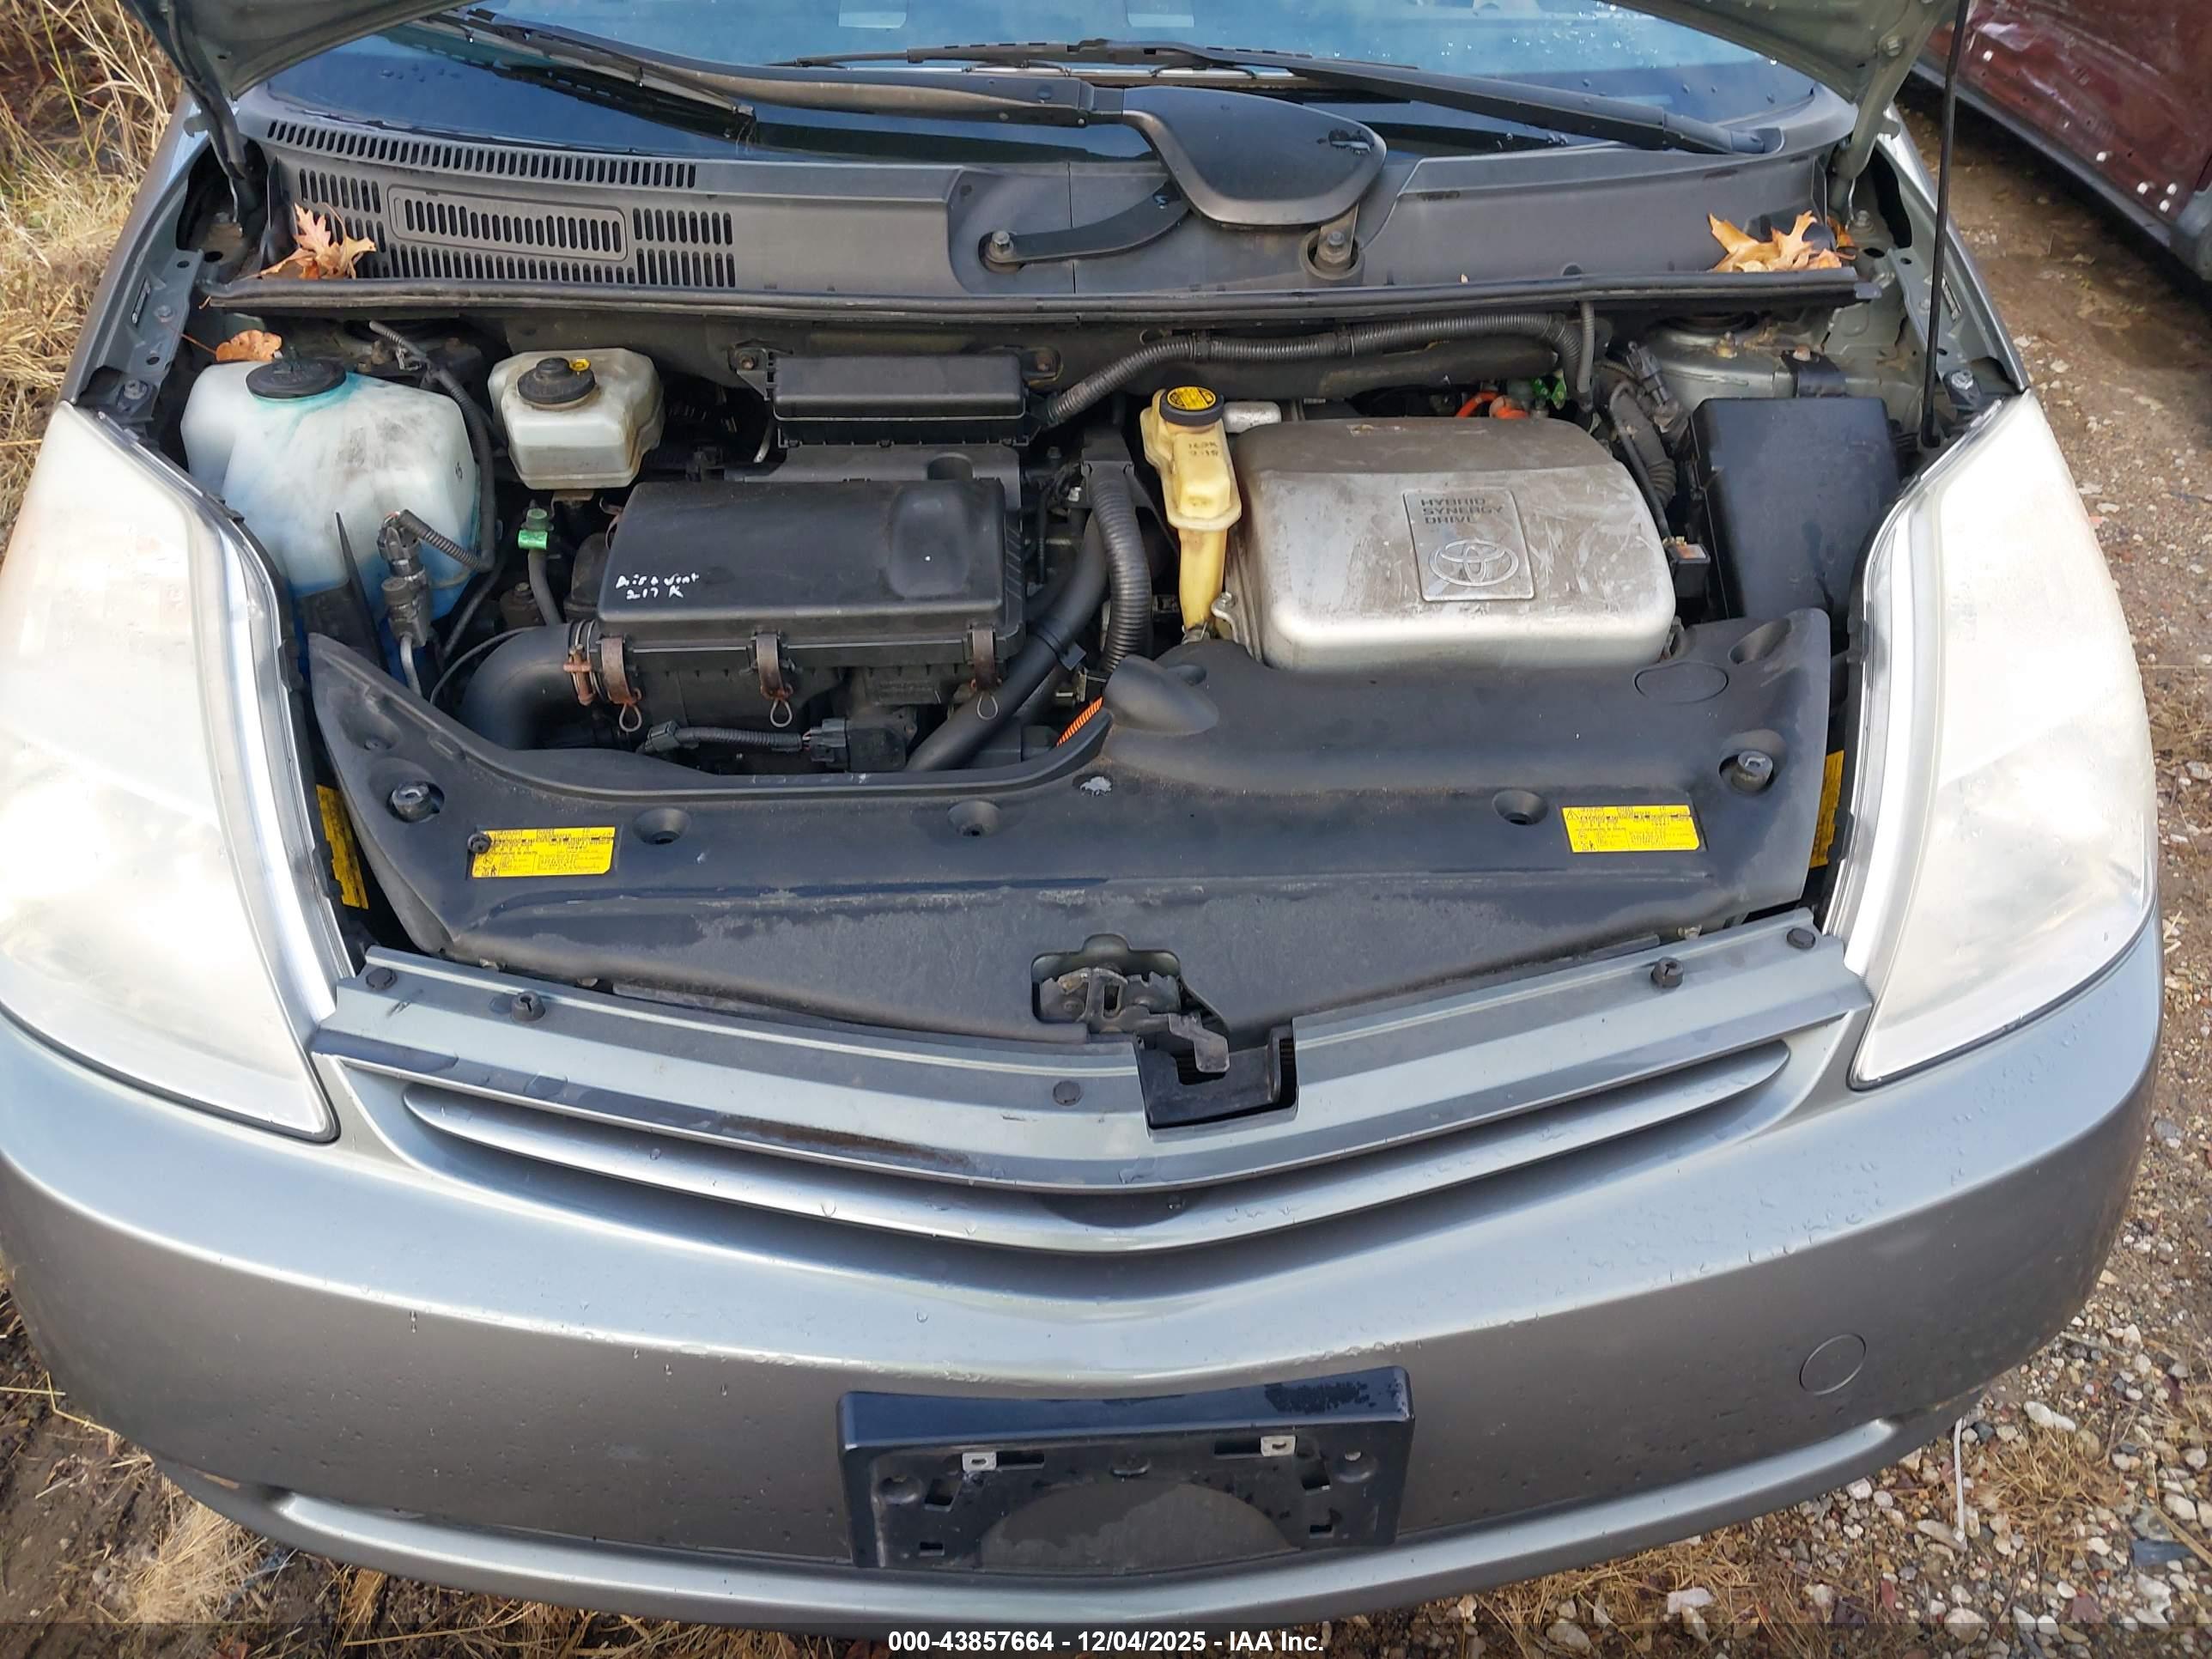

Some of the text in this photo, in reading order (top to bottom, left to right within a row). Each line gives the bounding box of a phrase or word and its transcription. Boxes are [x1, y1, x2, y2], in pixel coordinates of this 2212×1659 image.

[1421, 498, 1486, 507] HYBRID
[1422, 506, 1504, 516] SYNERGY
[1425, 515, 1479, 525] DRIVE
